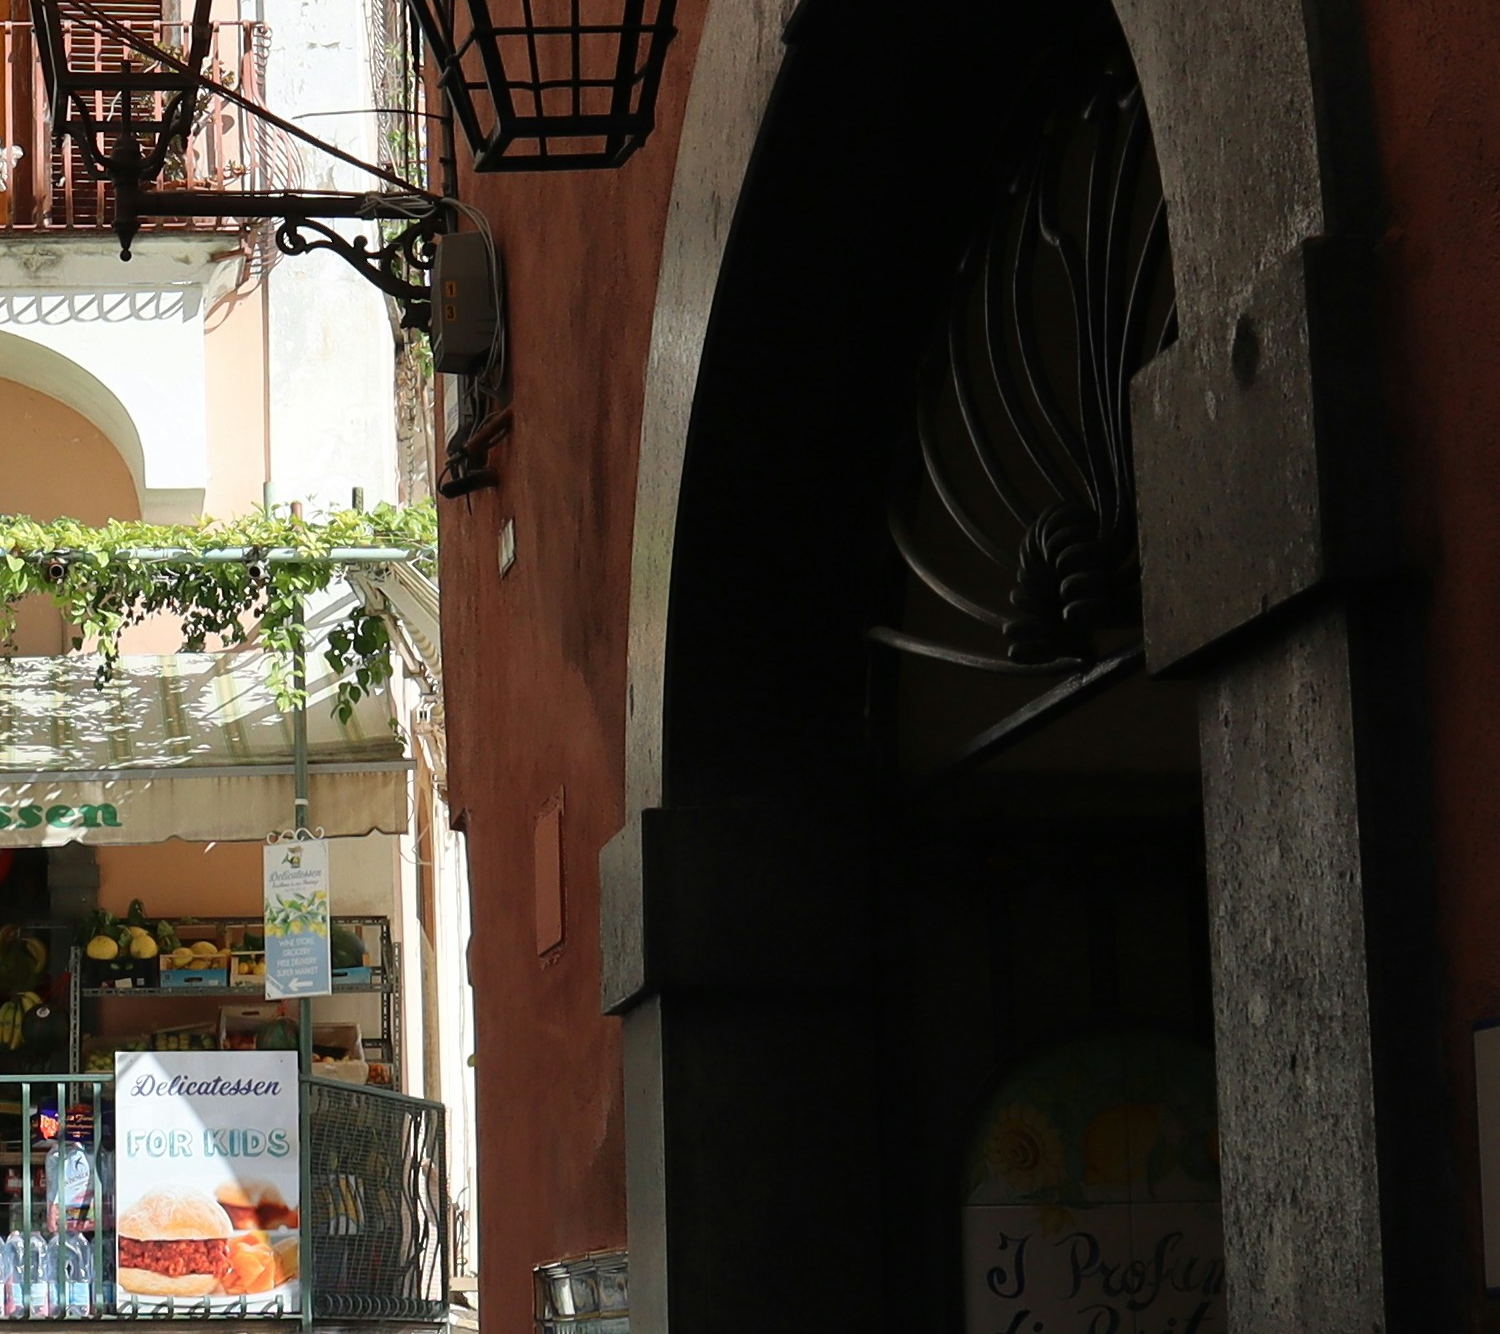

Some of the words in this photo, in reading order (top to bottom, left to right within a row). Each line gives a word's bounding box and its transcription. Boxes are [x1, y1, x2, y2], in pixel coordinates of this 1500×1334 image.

[130, 1073, 282, 1097] Delicatessen
[126, 1128, 194, 1158] FOR
[203, 1127, 290, 1158] KIDS
